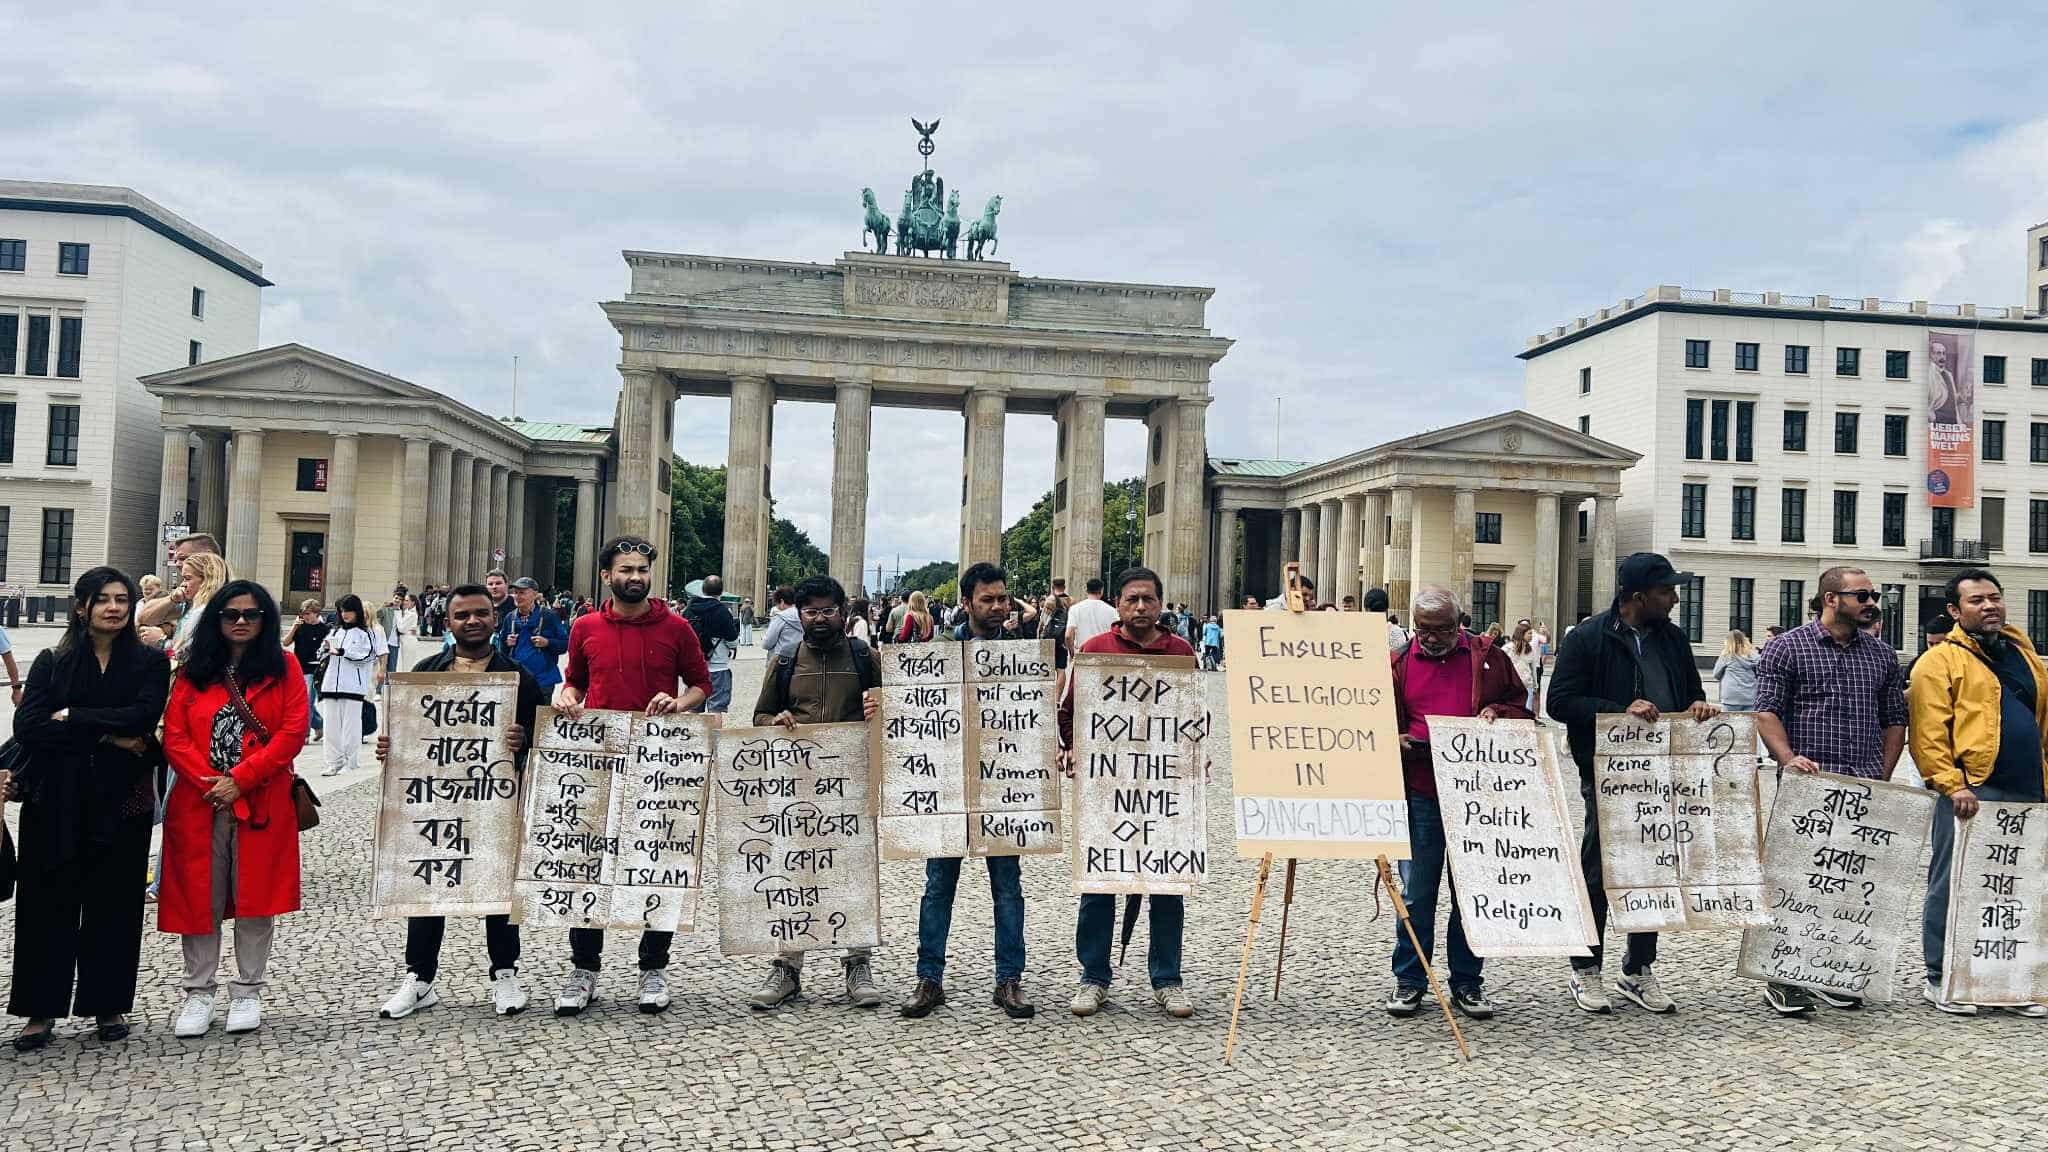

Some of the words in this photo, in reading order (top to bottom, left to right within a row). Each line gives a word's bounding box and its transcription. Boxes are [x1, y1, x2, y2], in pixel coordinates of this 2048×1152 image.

[1930, 441, 1960, 450] WELT
[1259, 626, 1364, 660] ENSURE
[898, 651, 950, 678] ধর্মের
[976, 648, 1050, 678] Schluss
[904, 686, 950, 708] নামে
[976, 684, 1005, 702] mit
[1102, 675, 1172, 704] STOP
[1248, 675, 1382, 706] RELIGIOUS
[420, 691, 502, 727] ধর্মের
[981, 708, 1042, 732] Politik
[554, 714, 613, 744] ধর্মের
[646, 722, 691, 740] Does
[886, 710, 961, 740] রাজনীতি
[1250, 726, 1377, 752] FREEDOM
[421, 737, 494, 766] নামে
[636, 746, 704, 767] Religion
[732, 738, 823, 771] তৌহিদি
[998, 736, 1018, 753] in
[1442, 733, 1536, 767] Schluss
[1608, 725, 1645, 744] Gibt
[1646, 730, 1663, 744] es
[1706, 723, 1737, 789] ?
[896, 752, 936, 778] বন্ধ
[980, 760, 1050, 780] Namen
[1090, 753, 1116, 778] IN
[1127, 752, 1182, 780] THE
[1295, 762, 1326, 786] IN
[1607, 758, 1651, 772] keine
[399, 760, 516, 804] রাজনীতি
[558, 772, 598, 799] কি
[718, 776, 803, 806] জনতার
[814, 777, 850, 798] মব
[1002, 786, 1035, 804] der
[1452, 770, 1482, 793] mit
[1493, 776, 1526, 792] der
[545, 799, 594, 831] শুধু
[902, 790, 939, 814] কর
[1114, 789, 1180, 817] NAME
[1464, 801, 1534, 830] Politik
[1634, 802, 1662, 822] für
[1678, 802, 1711, 816] den
[1824, 783, 1872, 822] রাষ্ট্র
[640, 813, 676, 840] only
[741, 801, 859, 837] জাস্টিসের
[981, 814, 1054, 848] Religion
[1240, 797, 1408, 837] BANGLADESH
[1792, 809, 1834, 839] তুমি
[1850, 824, 1898, 846] কবে
[1997, 808, 2033, 836] ধর্ম
[412, 817, 471, 854] বন্ধ
[533, 824, 619, 856] ইসলামের
[634, 830, 698, 862] against
[1112, 820, 1157, 845] OF
[1641, 820, 1694, 844] MOB
[738, 838, 773, 874] কি
[784, 848, 838, 873] কোন
[1087, 846, 1206, 874] RELIGION
[1463, 836, 1485, 855] im
[1496, 838, 1560, 863] Namen
[1814, 846, 1876, 874] সবার
[1985, 844, 2025, 866] যার
[409, 858, 473, 888] কর
[624, 868, 688, 888] ISLAM
[1498, 866, 1531, 885] der
[1980, 873, 2024, 895] যার
[754, 876, 830, 909] বিচার
[1618, 890, 1675, 912] Touhidi
[1689, 891, 1754, 913] Janata
[1805, 872, 1854, 895] হবে
[1862, 882, 1875, 906] ?
[537, 888, 575, 915] হয়
[582, 892, 597, 923] ?
[643, 894, 661, 928] ?
[1472, 894, 1562, 930] Religion
[1833, 908, 1874, 927] will
[1981, 898, 2028, 930] রাষ্ট্র
[766, 911, 821, 941] নাই
[828, 911, 846, 944] ?
[1800, 922, 1842, 944] State
[1771, 940, 1800, 960] for
[1972, 936, 2029, 960] সবার
